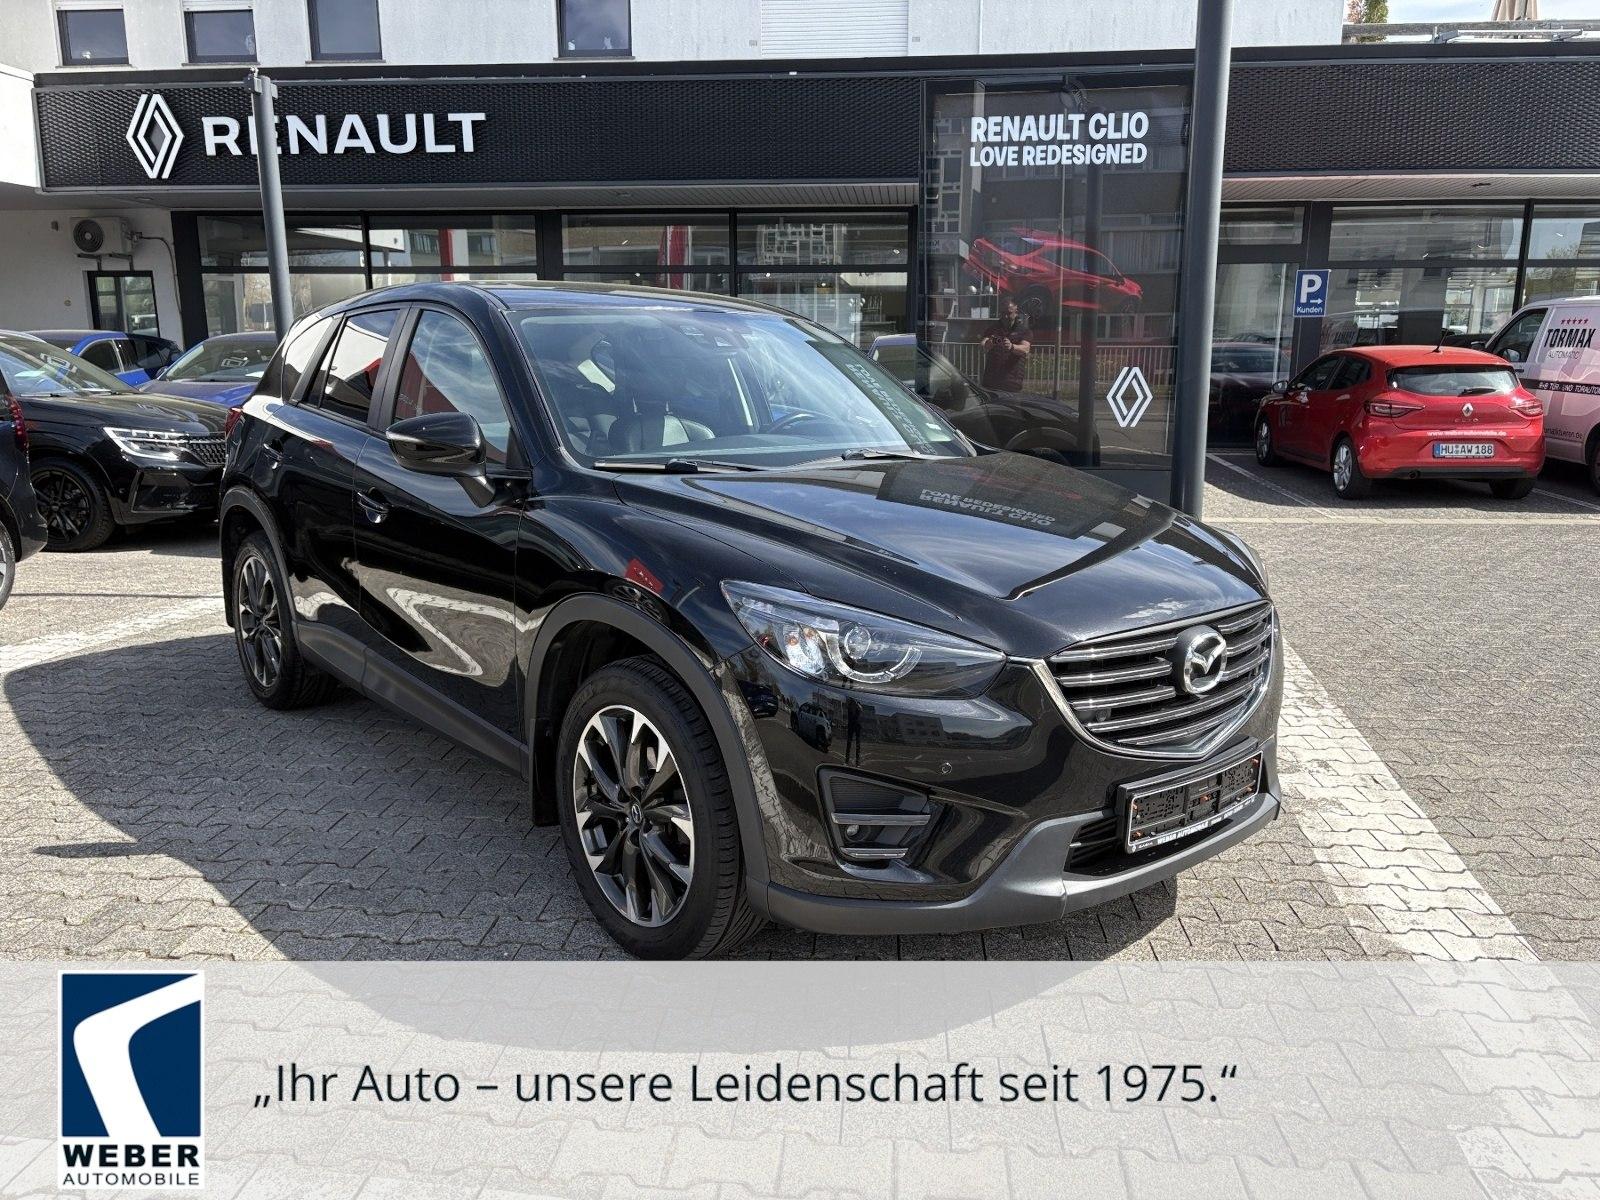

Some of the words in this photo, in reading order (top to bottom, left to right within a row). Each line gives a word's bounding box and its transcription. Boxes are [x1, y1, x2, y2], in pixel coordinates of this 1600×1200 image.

[970, 113, 1085, 142] RENAULT
[1088, 111, 1150, 140] CLIO
[969, 146, 1019, 167] LOVE
[1022, 143, 1148, 166] REDESIGNED
[1300, 274, 1323, 304] P
[1296, 306, 1323, 314] Kunden
[1544, 328, 1596, 348] TORMAX
[1440, 445, 1454, 455] HU
[1460, 445, 1473, 455] AW
